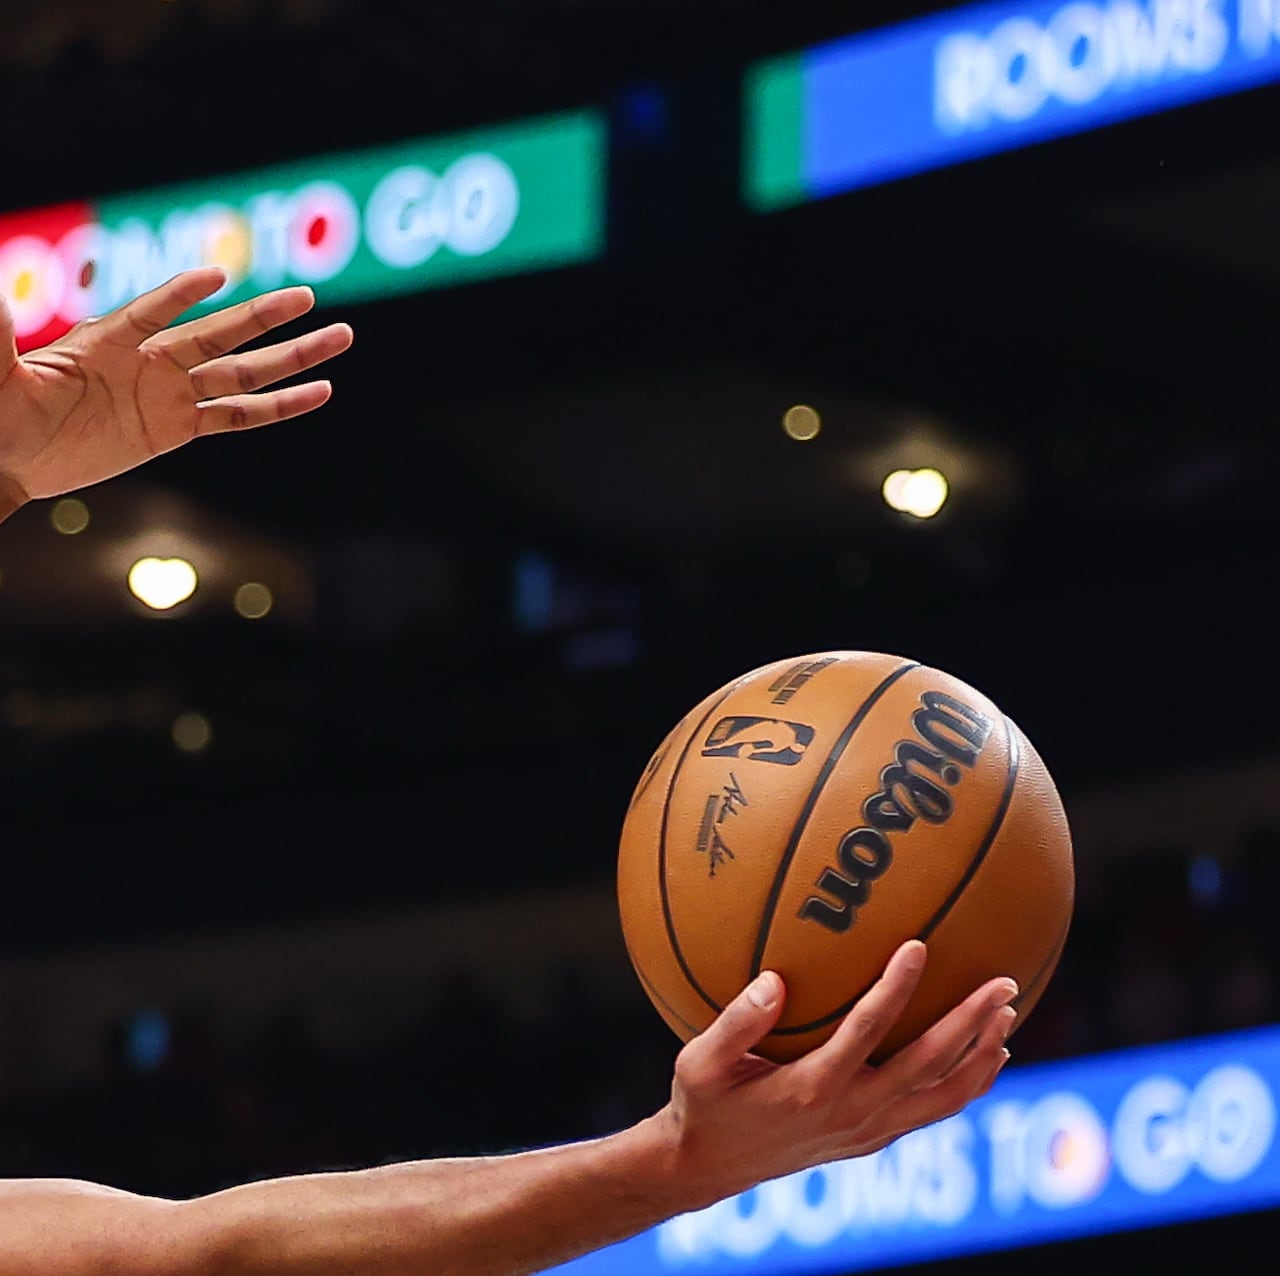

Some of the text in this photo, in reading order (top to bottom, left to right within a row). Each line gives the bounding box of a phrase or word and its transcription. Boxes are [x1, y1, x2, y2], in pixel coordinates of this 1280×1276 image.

[366, 152, 518, 268] GO
[797, 690, 994, 933] Wilson
[981, 1092, 1108, 1215] TO
[1114, 1064, 1276, 1194] GO
